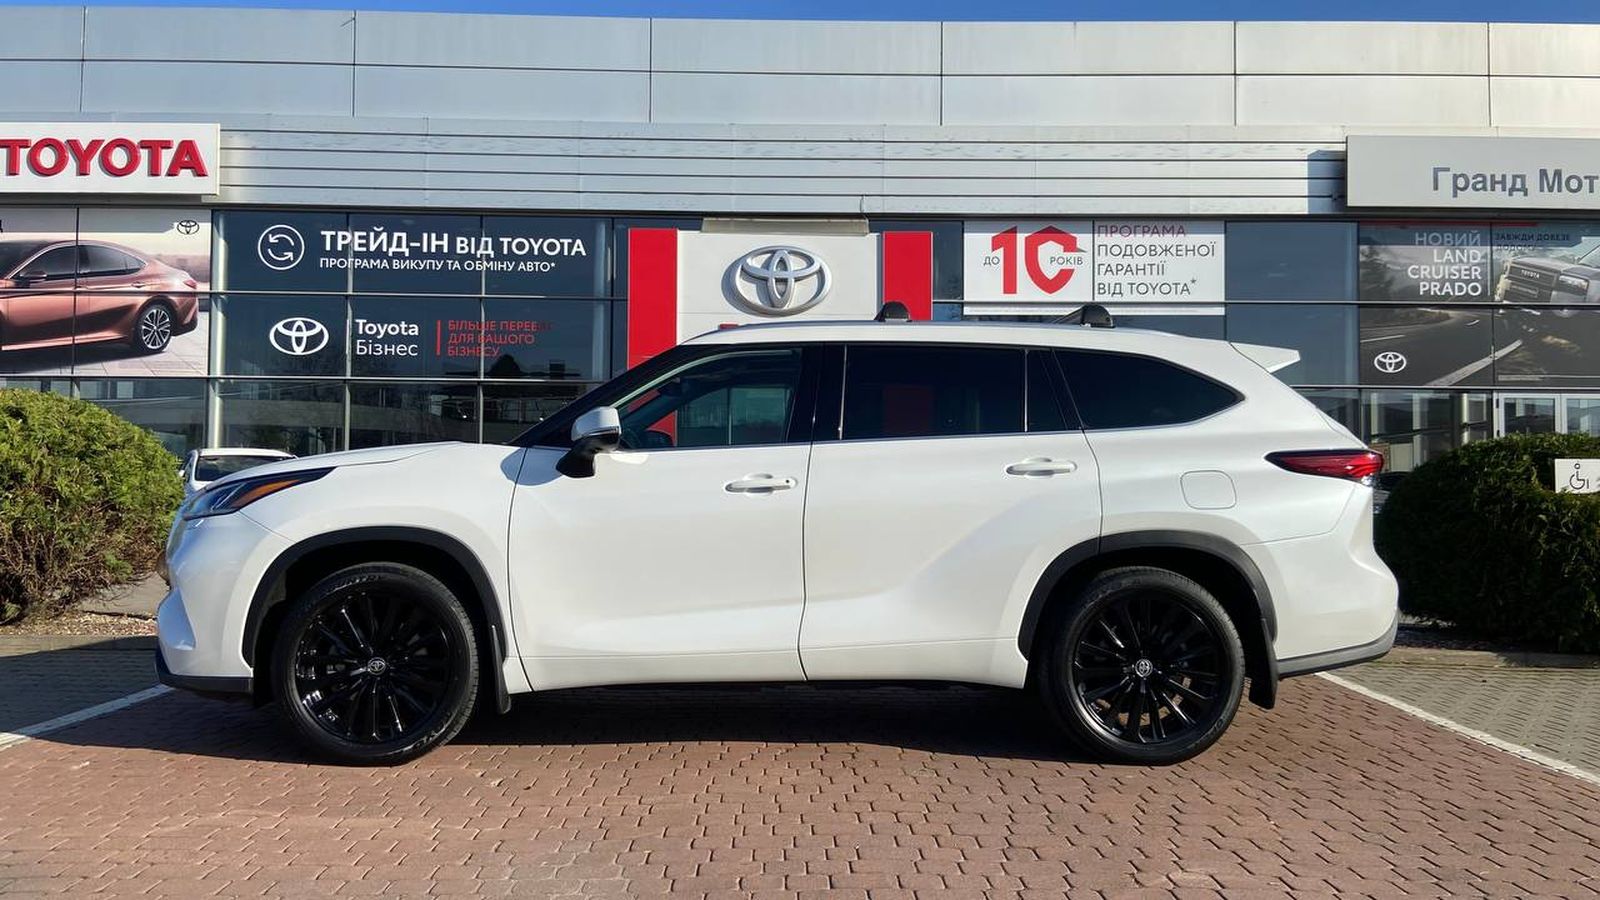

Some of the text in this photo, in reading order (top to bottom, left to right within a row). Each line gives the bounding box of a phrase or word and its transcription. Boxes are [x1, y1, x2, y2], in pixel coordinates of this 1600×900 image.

[0, 137, 209, 177] TOYOTA
[1432, 167, 1600, 198] Гранд Мот
[1097, 225, 1186, 238] ПРОГРАМА
[1415, 230, 1481, 247] НОВИЙ
[320, 226, 587, 258] ТРЕЙД-ІН ВІД TOYOTA
[1097, 241, 1217, 259] ПОДОВЖЕНОЇ
[1433, 249, 1481, 263] LAND
[319, 257, 390, 270] ПРОГРАМА
[392, 259, 444, 271] ВИКУПУ
[447, 260, 461, 271] ТА
[464, 260, 515, 272] ОБМІНУ
[983, 256, 1000, 266] ДО
[1049, 256, 1084, 266] РОКІВ
[1097, 260, 1167, 276] ГАРАНТІЇ
[1407, 265, 1482, 280] CRUISER
[1097, 283, 1123, 297] ВІД
[1419, 281, 1482, 296] PRADO
[354, 318, 420, 339] Toyota
[447, 319, 497, 331] БІЛЬШЕ
[447, 333, 535, 345] ДЛЯ ВАШОГО
[355, 339, 419, 357] Бізнес
[447, 345, 501, 357] БІЗНЕСУ
